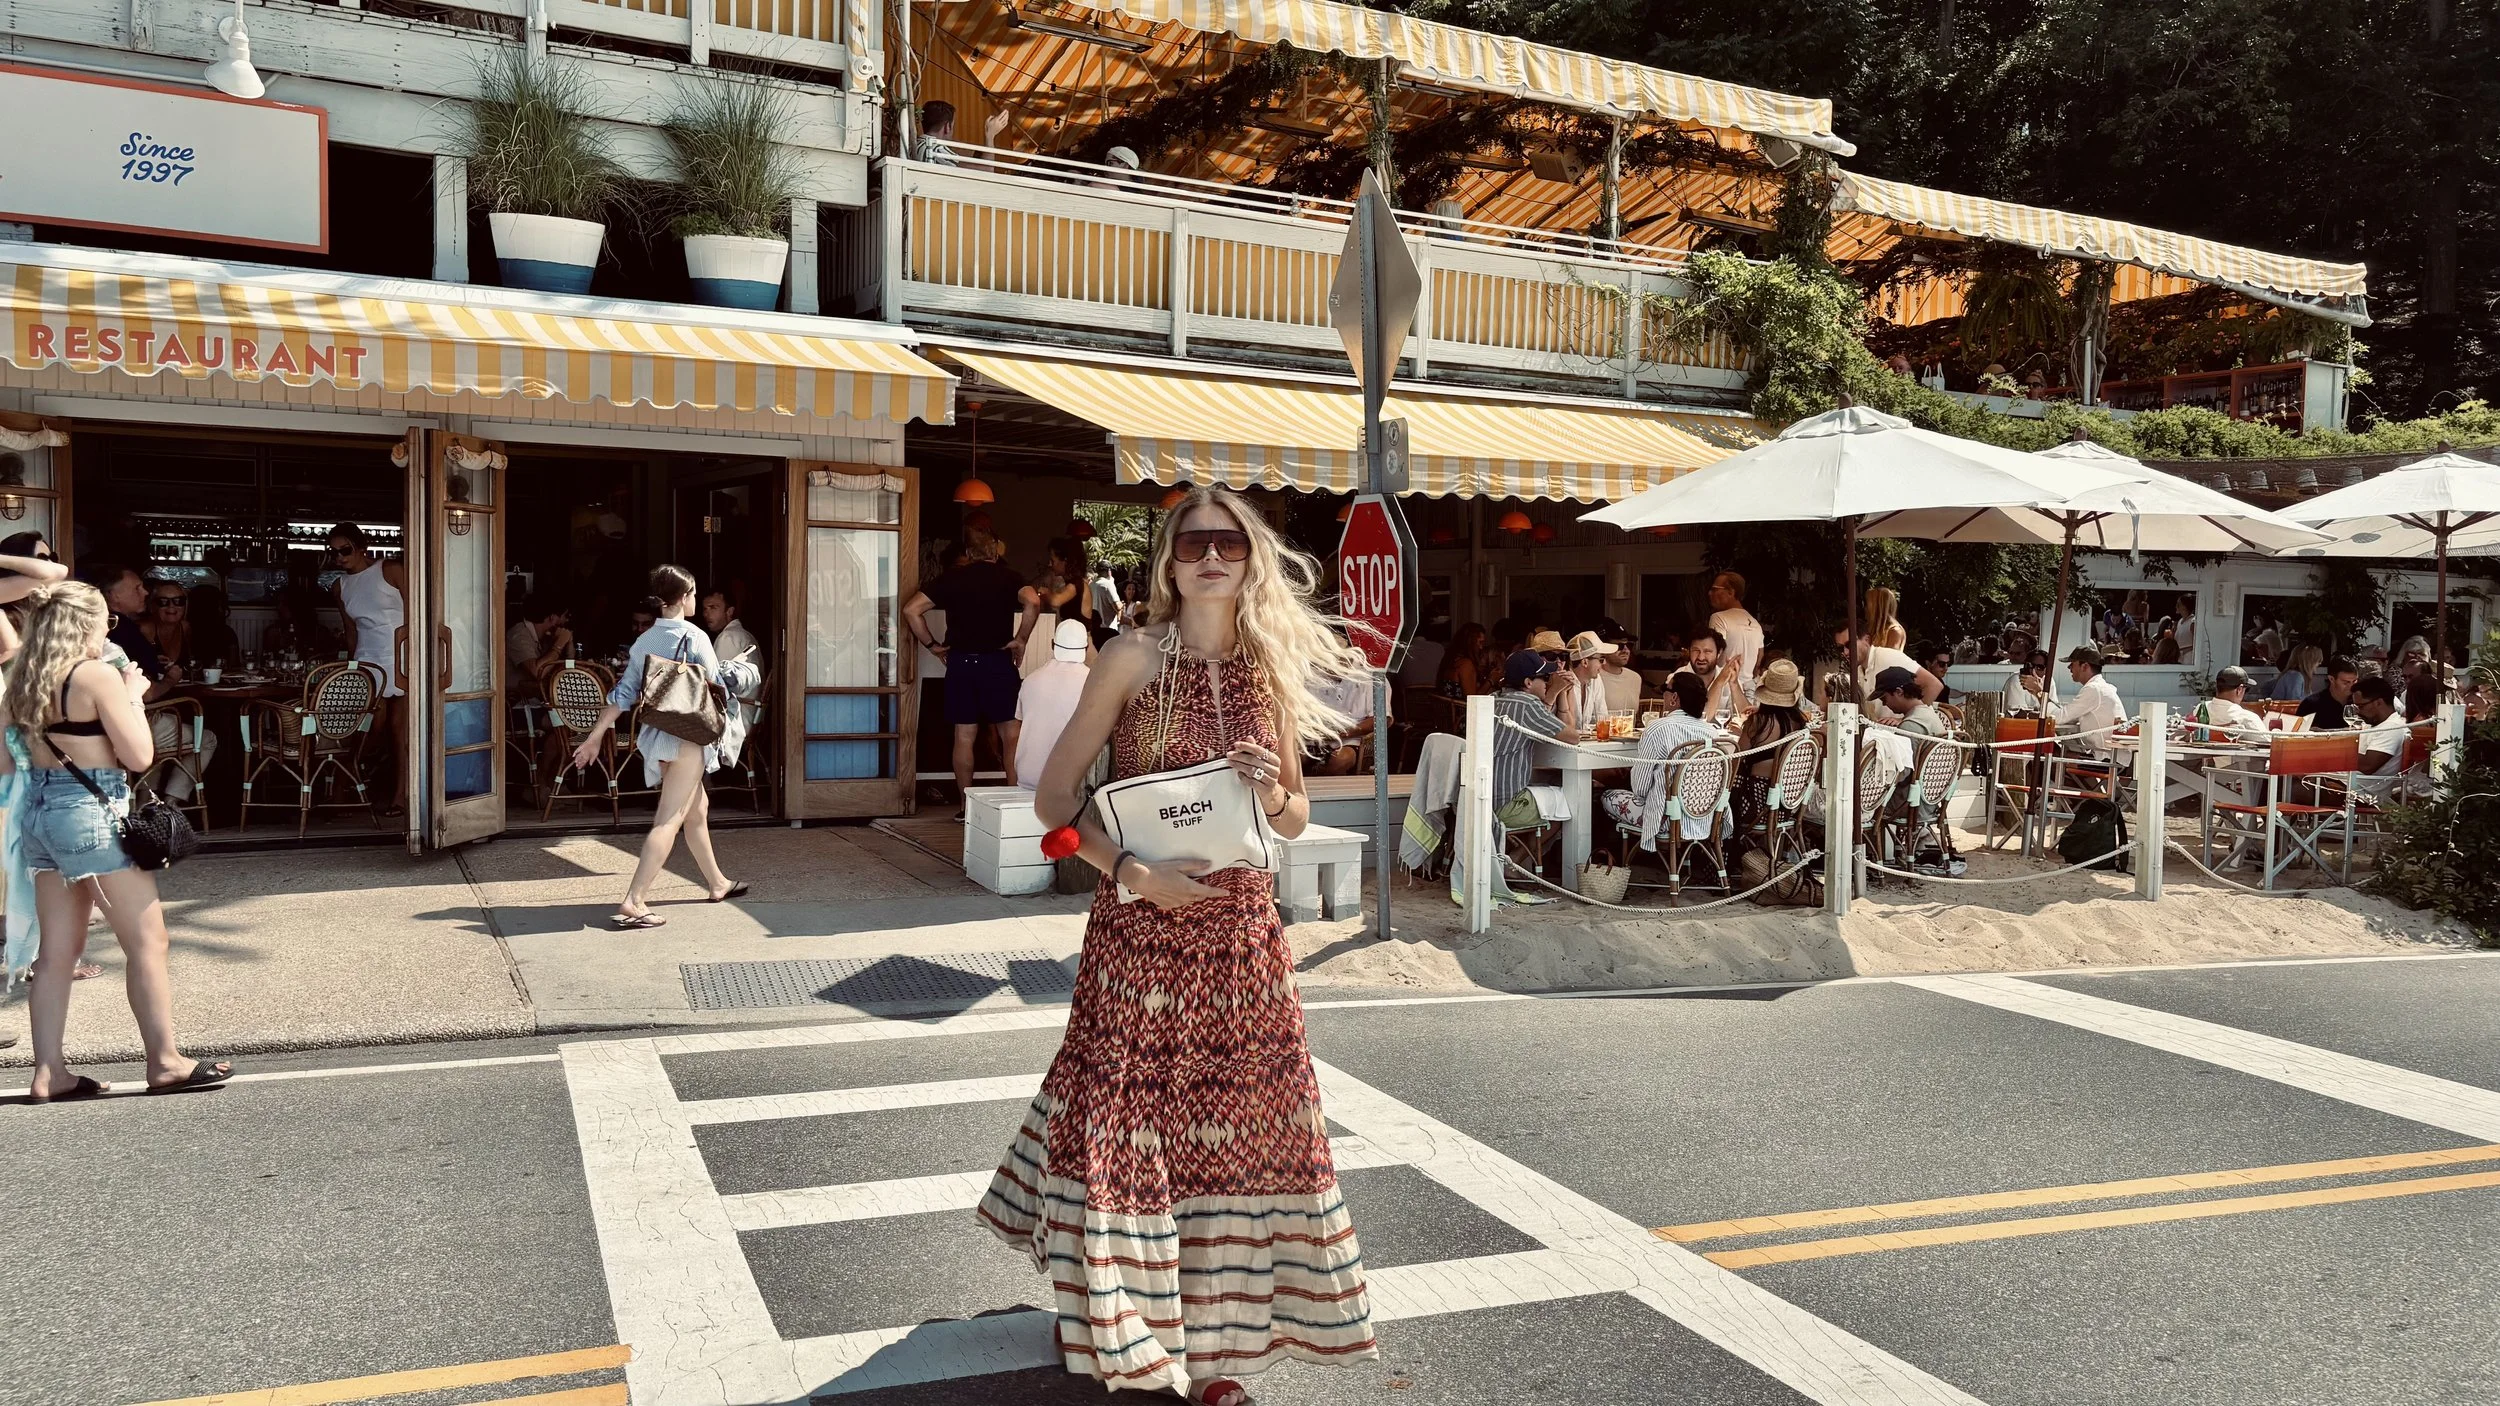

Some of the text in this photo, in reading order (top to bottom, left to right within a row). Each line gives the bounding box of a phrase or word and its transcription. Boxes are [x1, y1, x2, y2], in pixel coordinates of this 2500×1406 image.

[120, 132, 195, 161] Since
[121, 159, 195, 186] 1997
[28, 323, 368, 380] RESTAURANT
[1343, 553, 1397, 616] STOP
[1159, 799, 1213, 820] BEACH
[1172, 816, 1203, 829] STUFF
